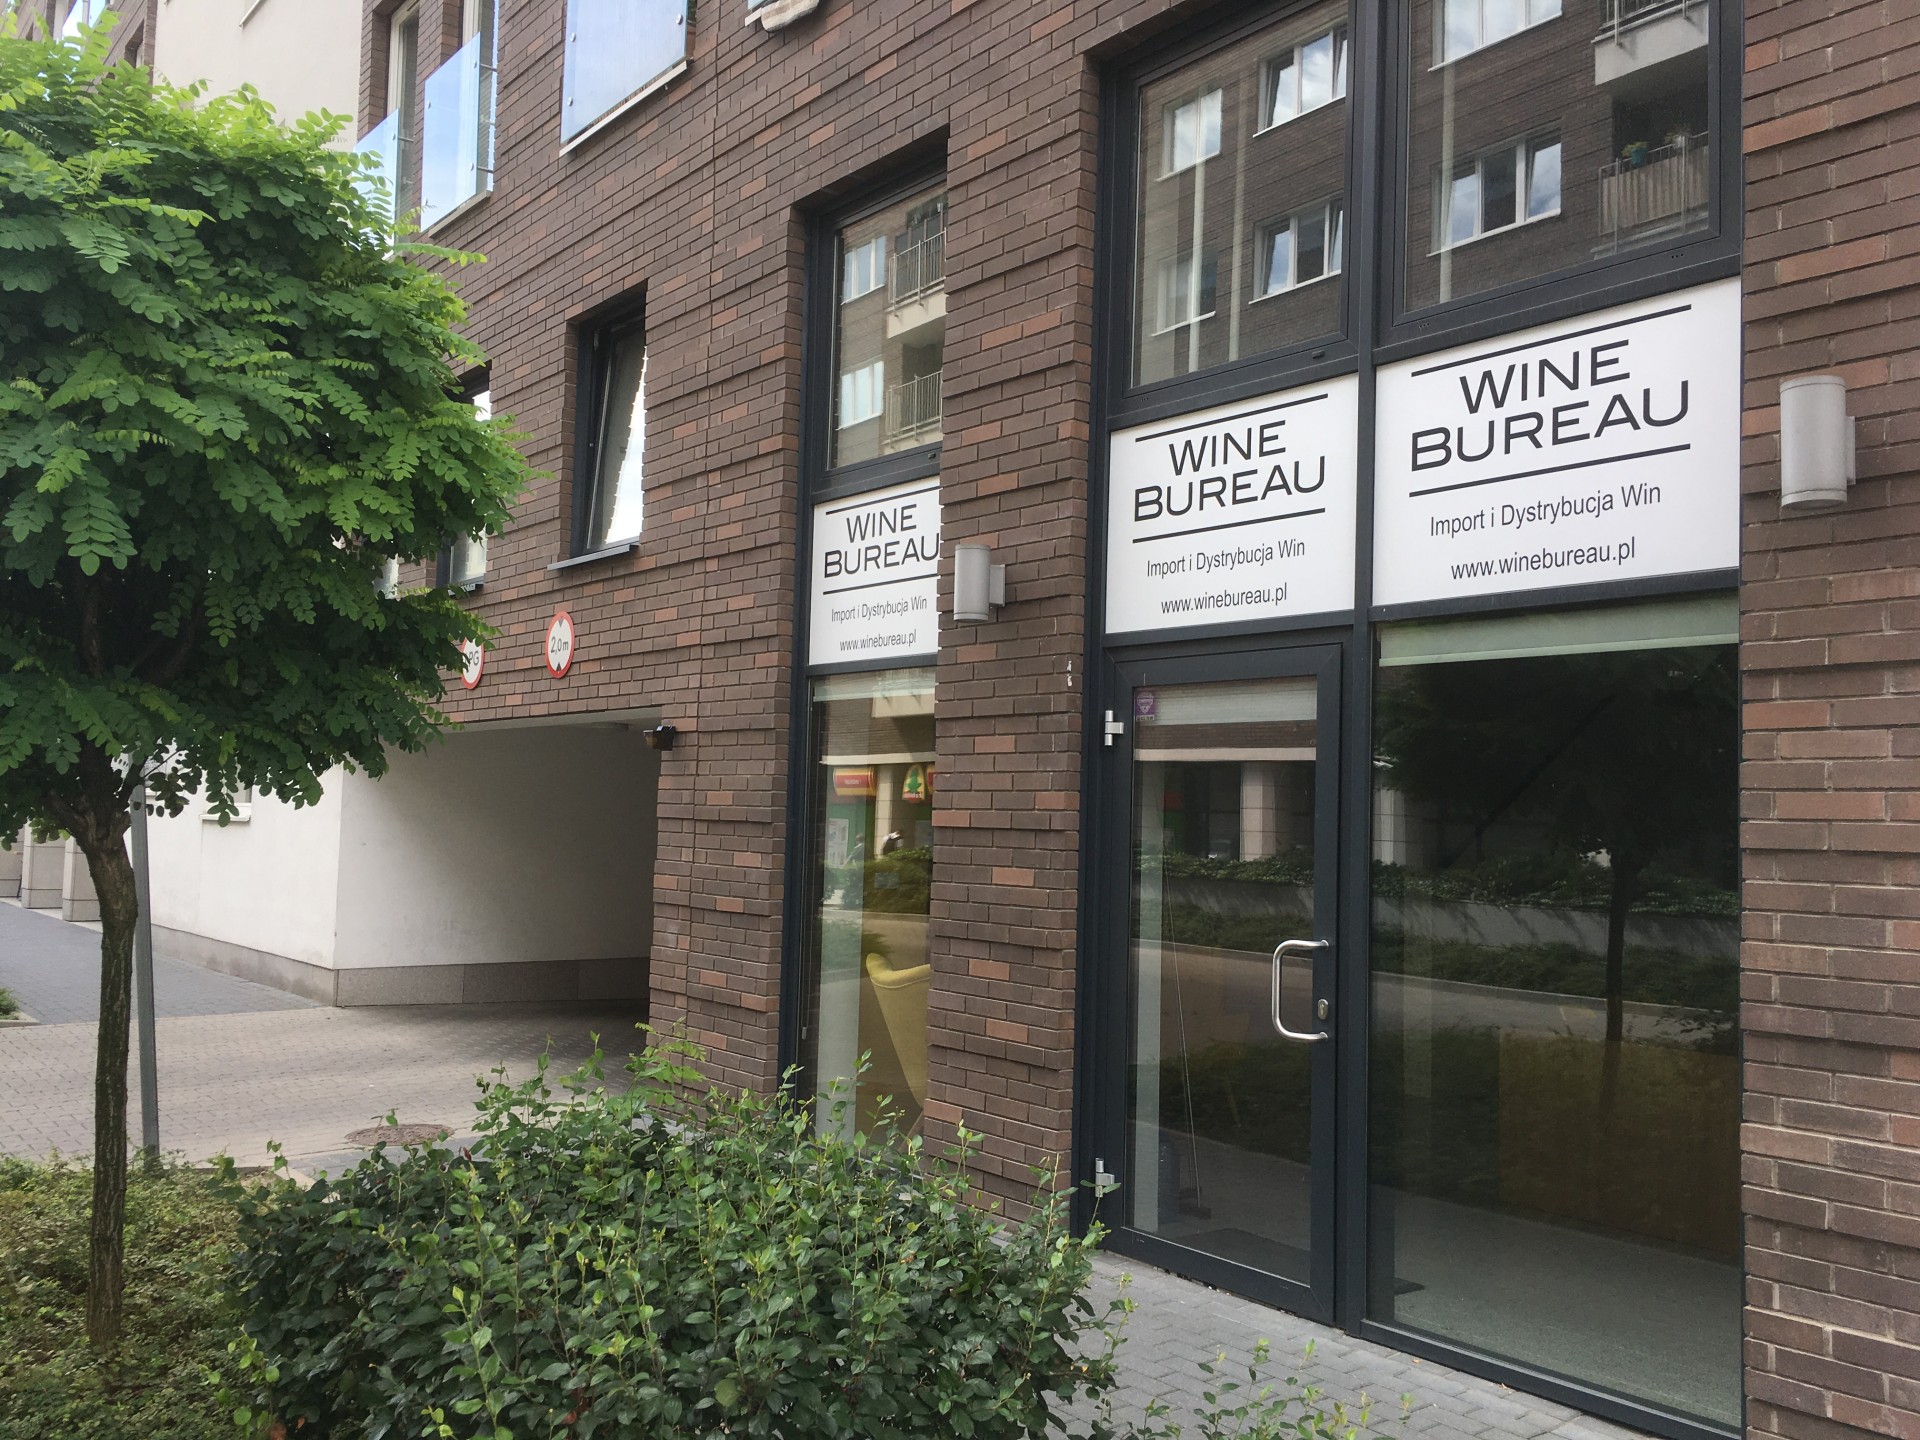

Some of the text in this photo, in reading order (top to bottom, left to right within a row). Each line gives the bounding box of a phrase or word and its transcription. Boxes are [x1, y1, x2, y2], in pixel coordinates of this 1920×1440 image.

[1459, 339, 1630, 415] WINE
[1168, 419, 1286, 476] WINE
[1411, 380, 1689, 472] BUREAU
[1134, 455, 1325, 522] BUREAU
[1430, 483, 1661, 538] Import i Dystrybucja Win
[846, 503, 917, 543] WINE
[824, 532, 940, 578] BUREAU
[1146, 539, 1305, 579] Import i Dystrybucja Win
[1450, 536, 1635, 581] www.winebureau.pl
[831, 606, 856, 624] Import
[861, 599, 909, 620] Dystrybucja
[910, 595, 927, 611] Win
[1161, 582, 1288, 614] www.winebureau.pl
[840, 629, 916, 651] www.winebureau.pl
